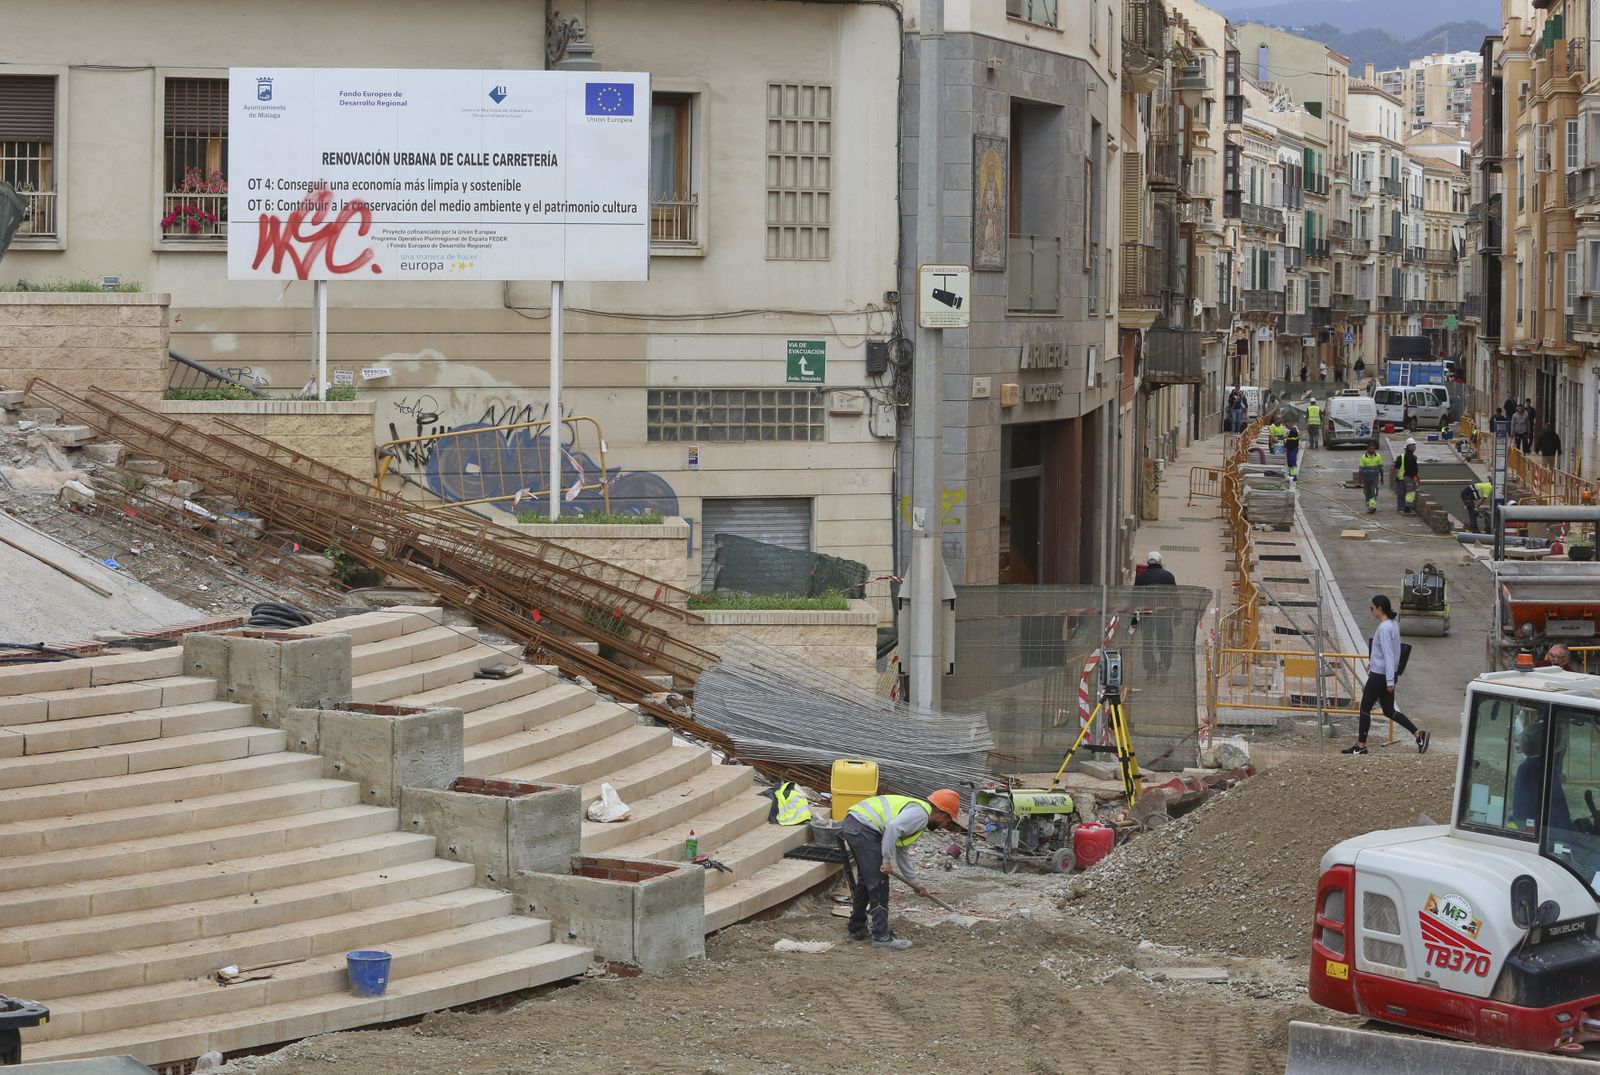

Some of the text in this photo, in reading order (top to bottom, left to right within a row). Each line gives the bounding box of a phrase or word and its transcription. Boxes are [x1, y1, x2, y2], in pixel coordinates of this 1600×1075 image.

[363, 91, 392, 99] Europeo
[243, 104, 287, 113] Ayuntamiento
[377, 100, 408, 108] Regional
[322, 149, 558, 167] RENOVACIÓN URBANA DE CALLE CARRETERÍA
[247, 178, 522, 194] OT 4: Conseguir una economía más limpia y sostenible
[247, 199, 637, 215] OT 6: Contribuir a la conservación del medio ambiente y el patrimonio cultura
[372, 235, 397, 243] Programa
[447, 253, 456, 261] de
[457, 253, 477, 261] hacer
[400, 260, 444, 272] europa
[1024, 383, 1064, 403] DEPORTES
[1423, 942, 1492, 978] TB370
